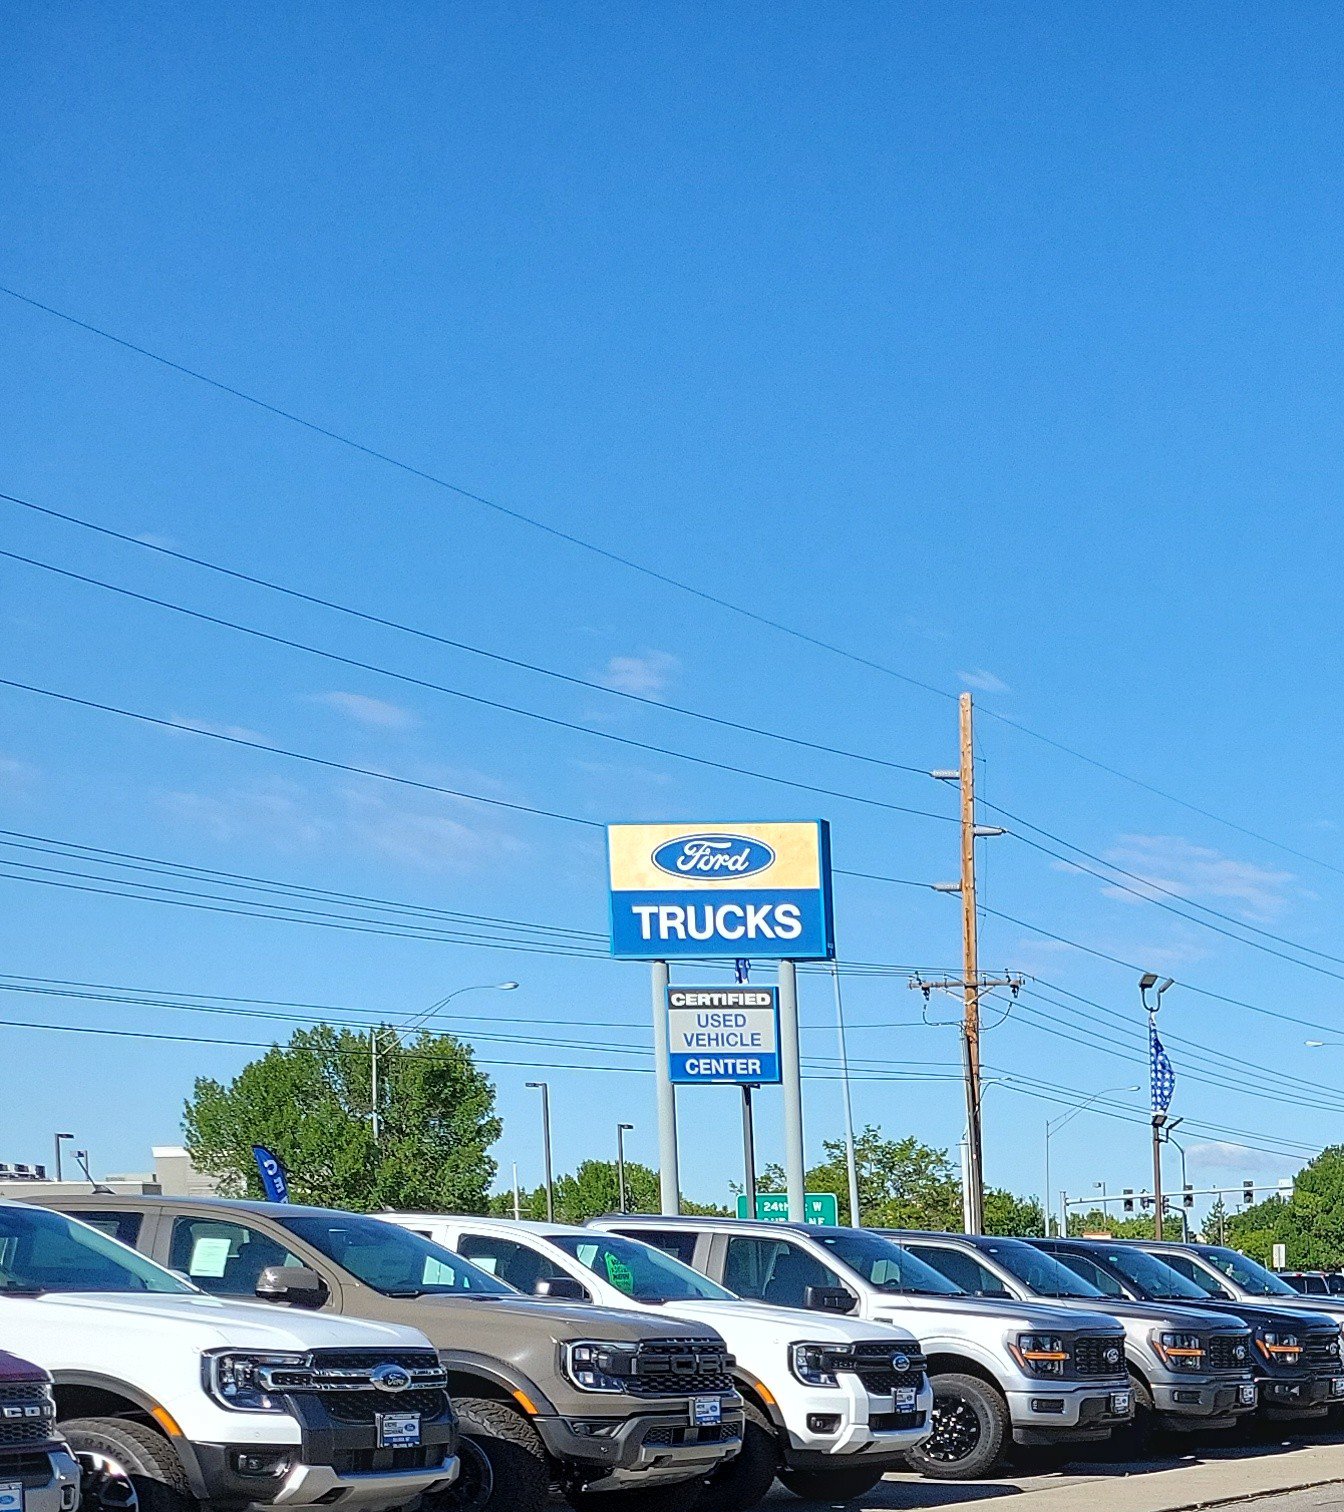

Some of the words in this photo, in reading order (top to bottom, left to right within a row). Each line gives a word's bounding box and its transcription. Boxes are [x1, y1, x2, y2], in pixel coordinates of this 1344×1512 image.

[676, 840, 751, 871] Ford
[632, 904, 802, 940] TRUCKS
[670, 992, 771, 1006] CERTIFIED
[697, 1013, 747, 1028] USED
[683, 1033, 762, 1047] VEHICLE
[685, 1059, 761, 1075] CENTER
[812, 1201, 822, 1212] W
